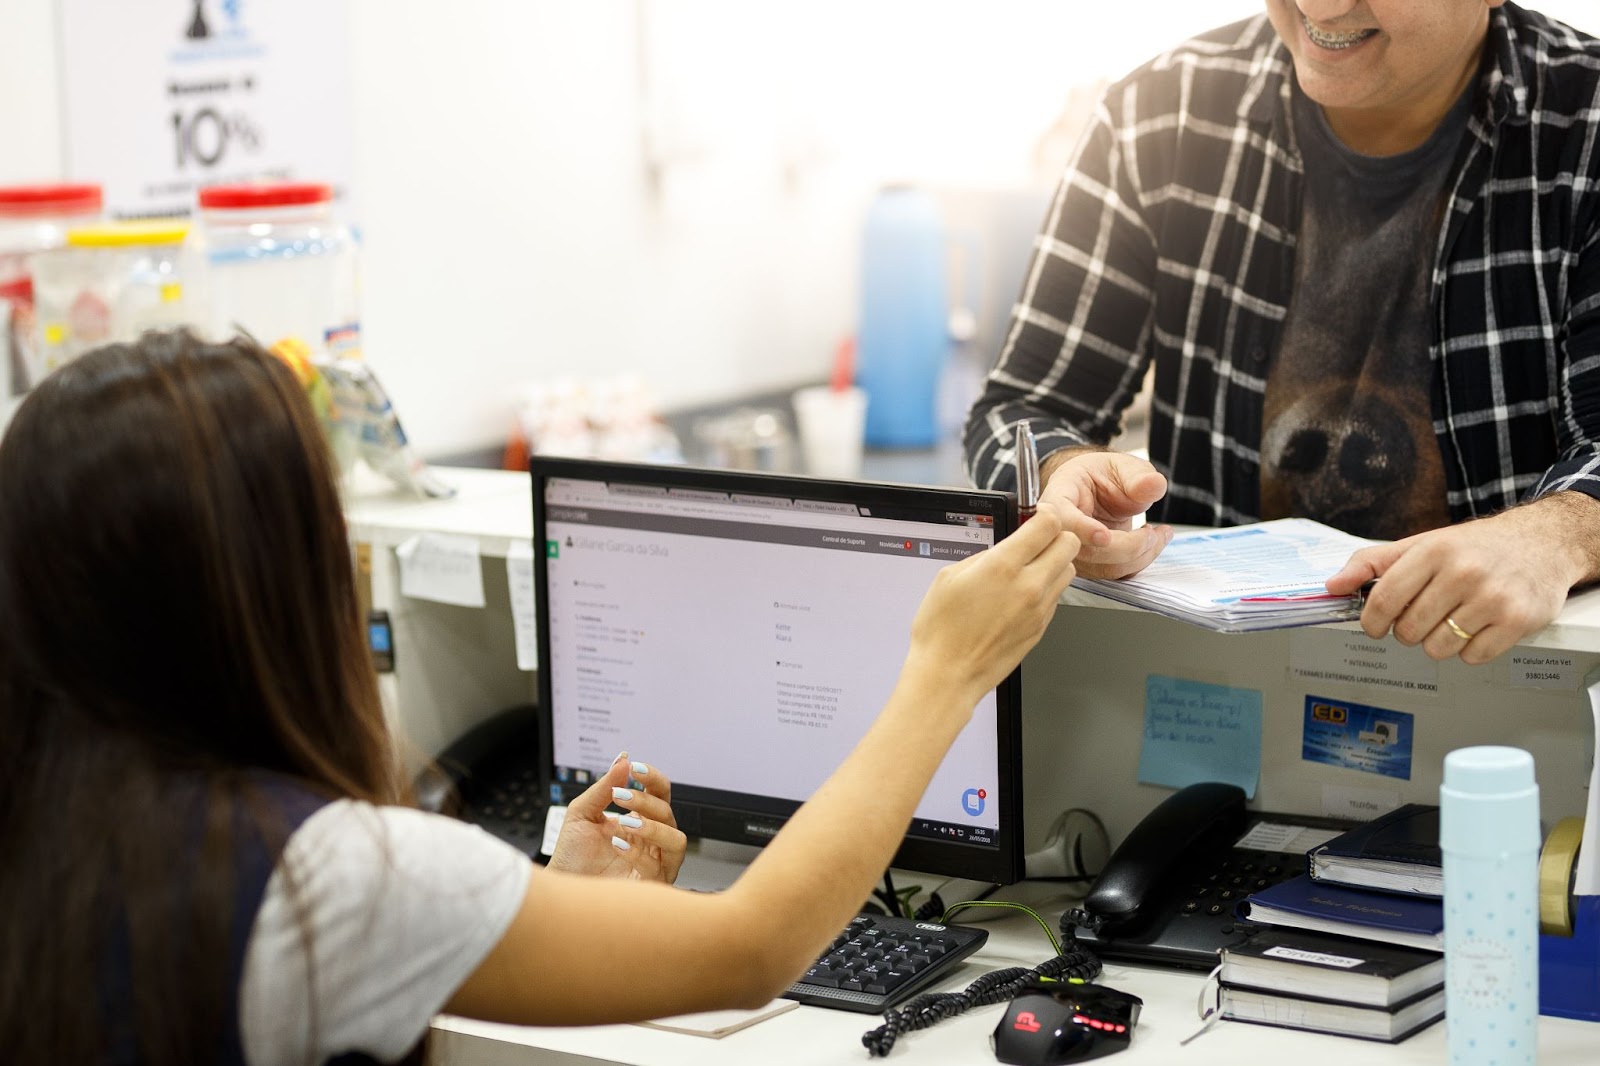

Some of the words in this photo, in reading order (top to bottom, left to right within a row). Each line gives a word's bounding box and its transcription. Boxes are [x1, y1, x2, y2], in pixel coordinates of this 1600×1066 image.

[822, 535, 840, 544] Central
[847, 538, 866, 547] Suporte
[879, 541, 905, 549] Novidades
[1349, 644, 1387, 654] ULTRASSOM
[1349, 659, 1388, 670] INTERNAÇÃO
[1299, 669, 1324, 678] EXAMES
[1325, 672, 1356, 682] EXTERNOS
[1357, 675, 1403, 688] LABORATORIAIS
[1314, 704, 1347, 723] ED
